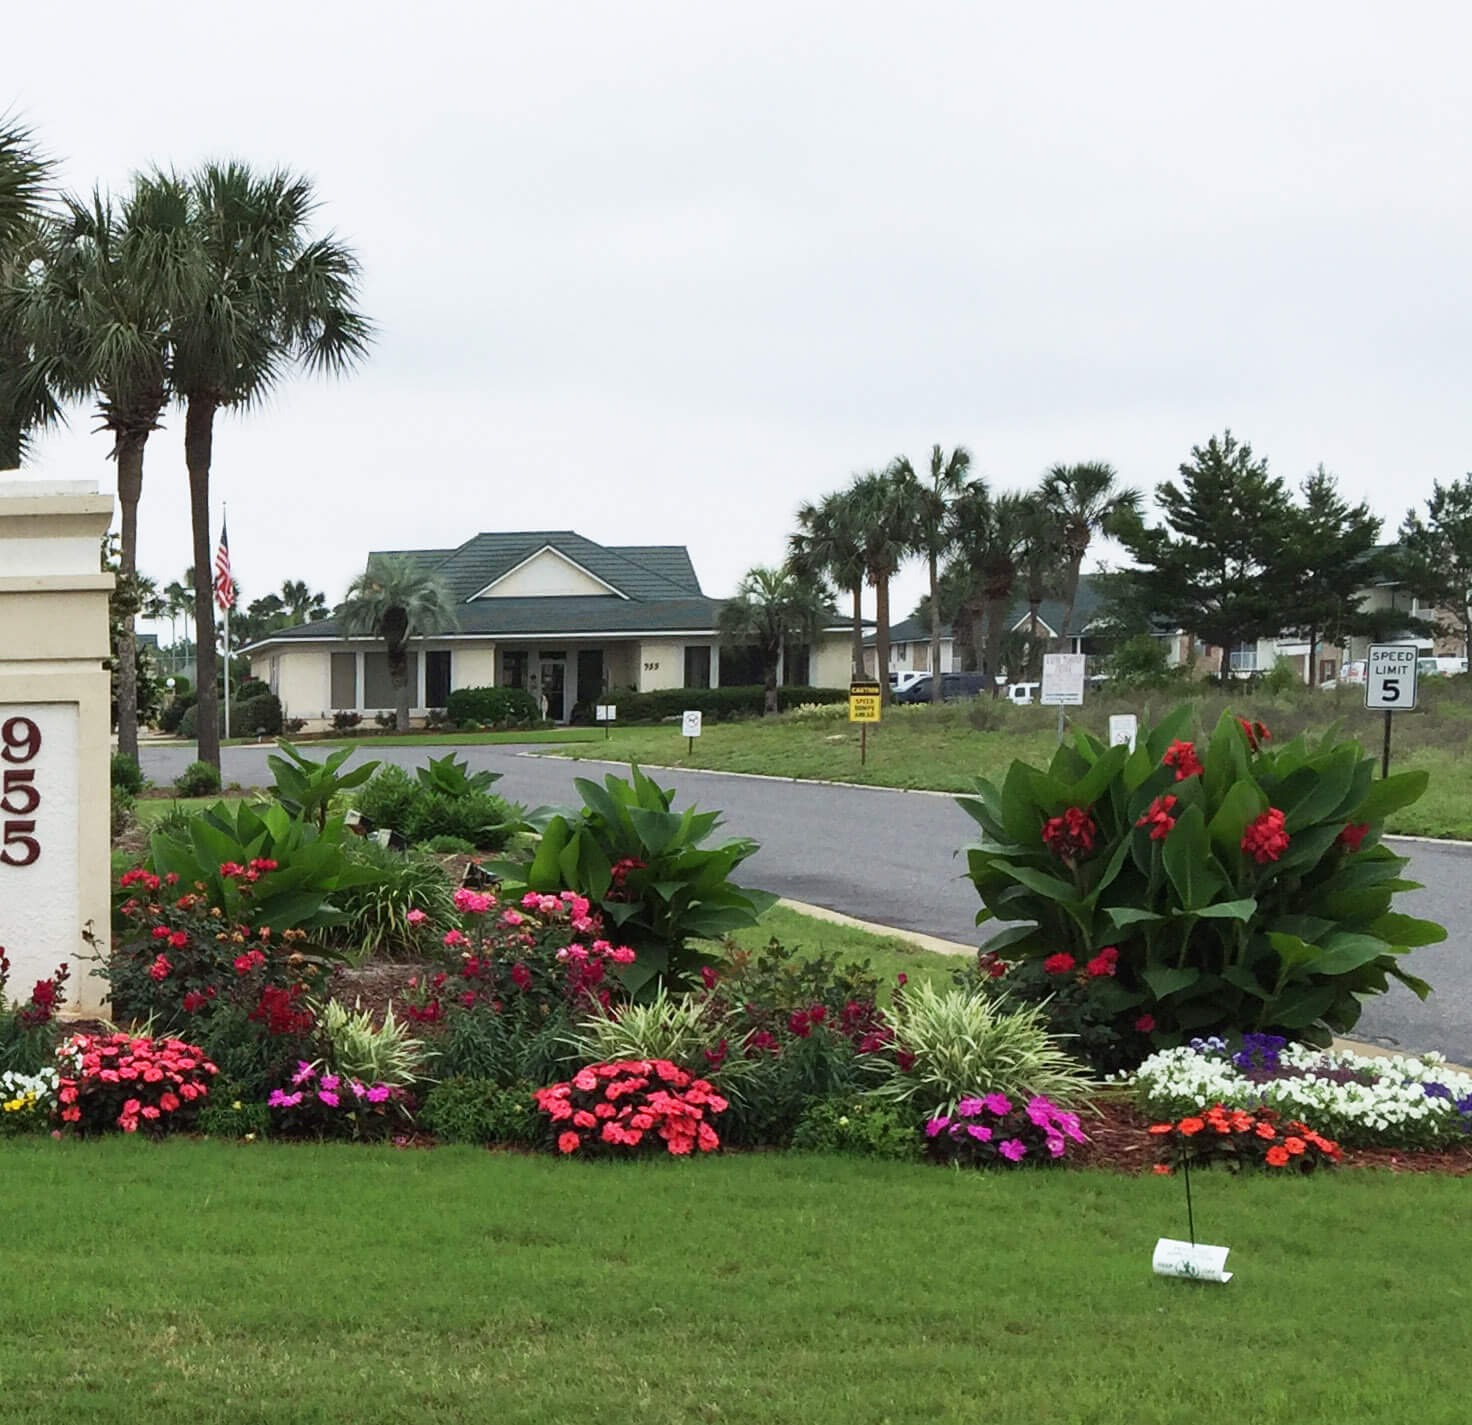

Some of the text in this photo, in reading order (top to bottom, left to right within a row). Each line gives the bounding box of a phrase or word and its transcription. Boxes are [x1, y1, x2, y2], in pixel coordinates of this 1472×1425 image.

[1372, 651, 1414, 661] SPEED
[1375, 665, 1408, 675] LIMIT
[1381, 679, 1400, 702] 5
[0, 716, 41, 867] 955
